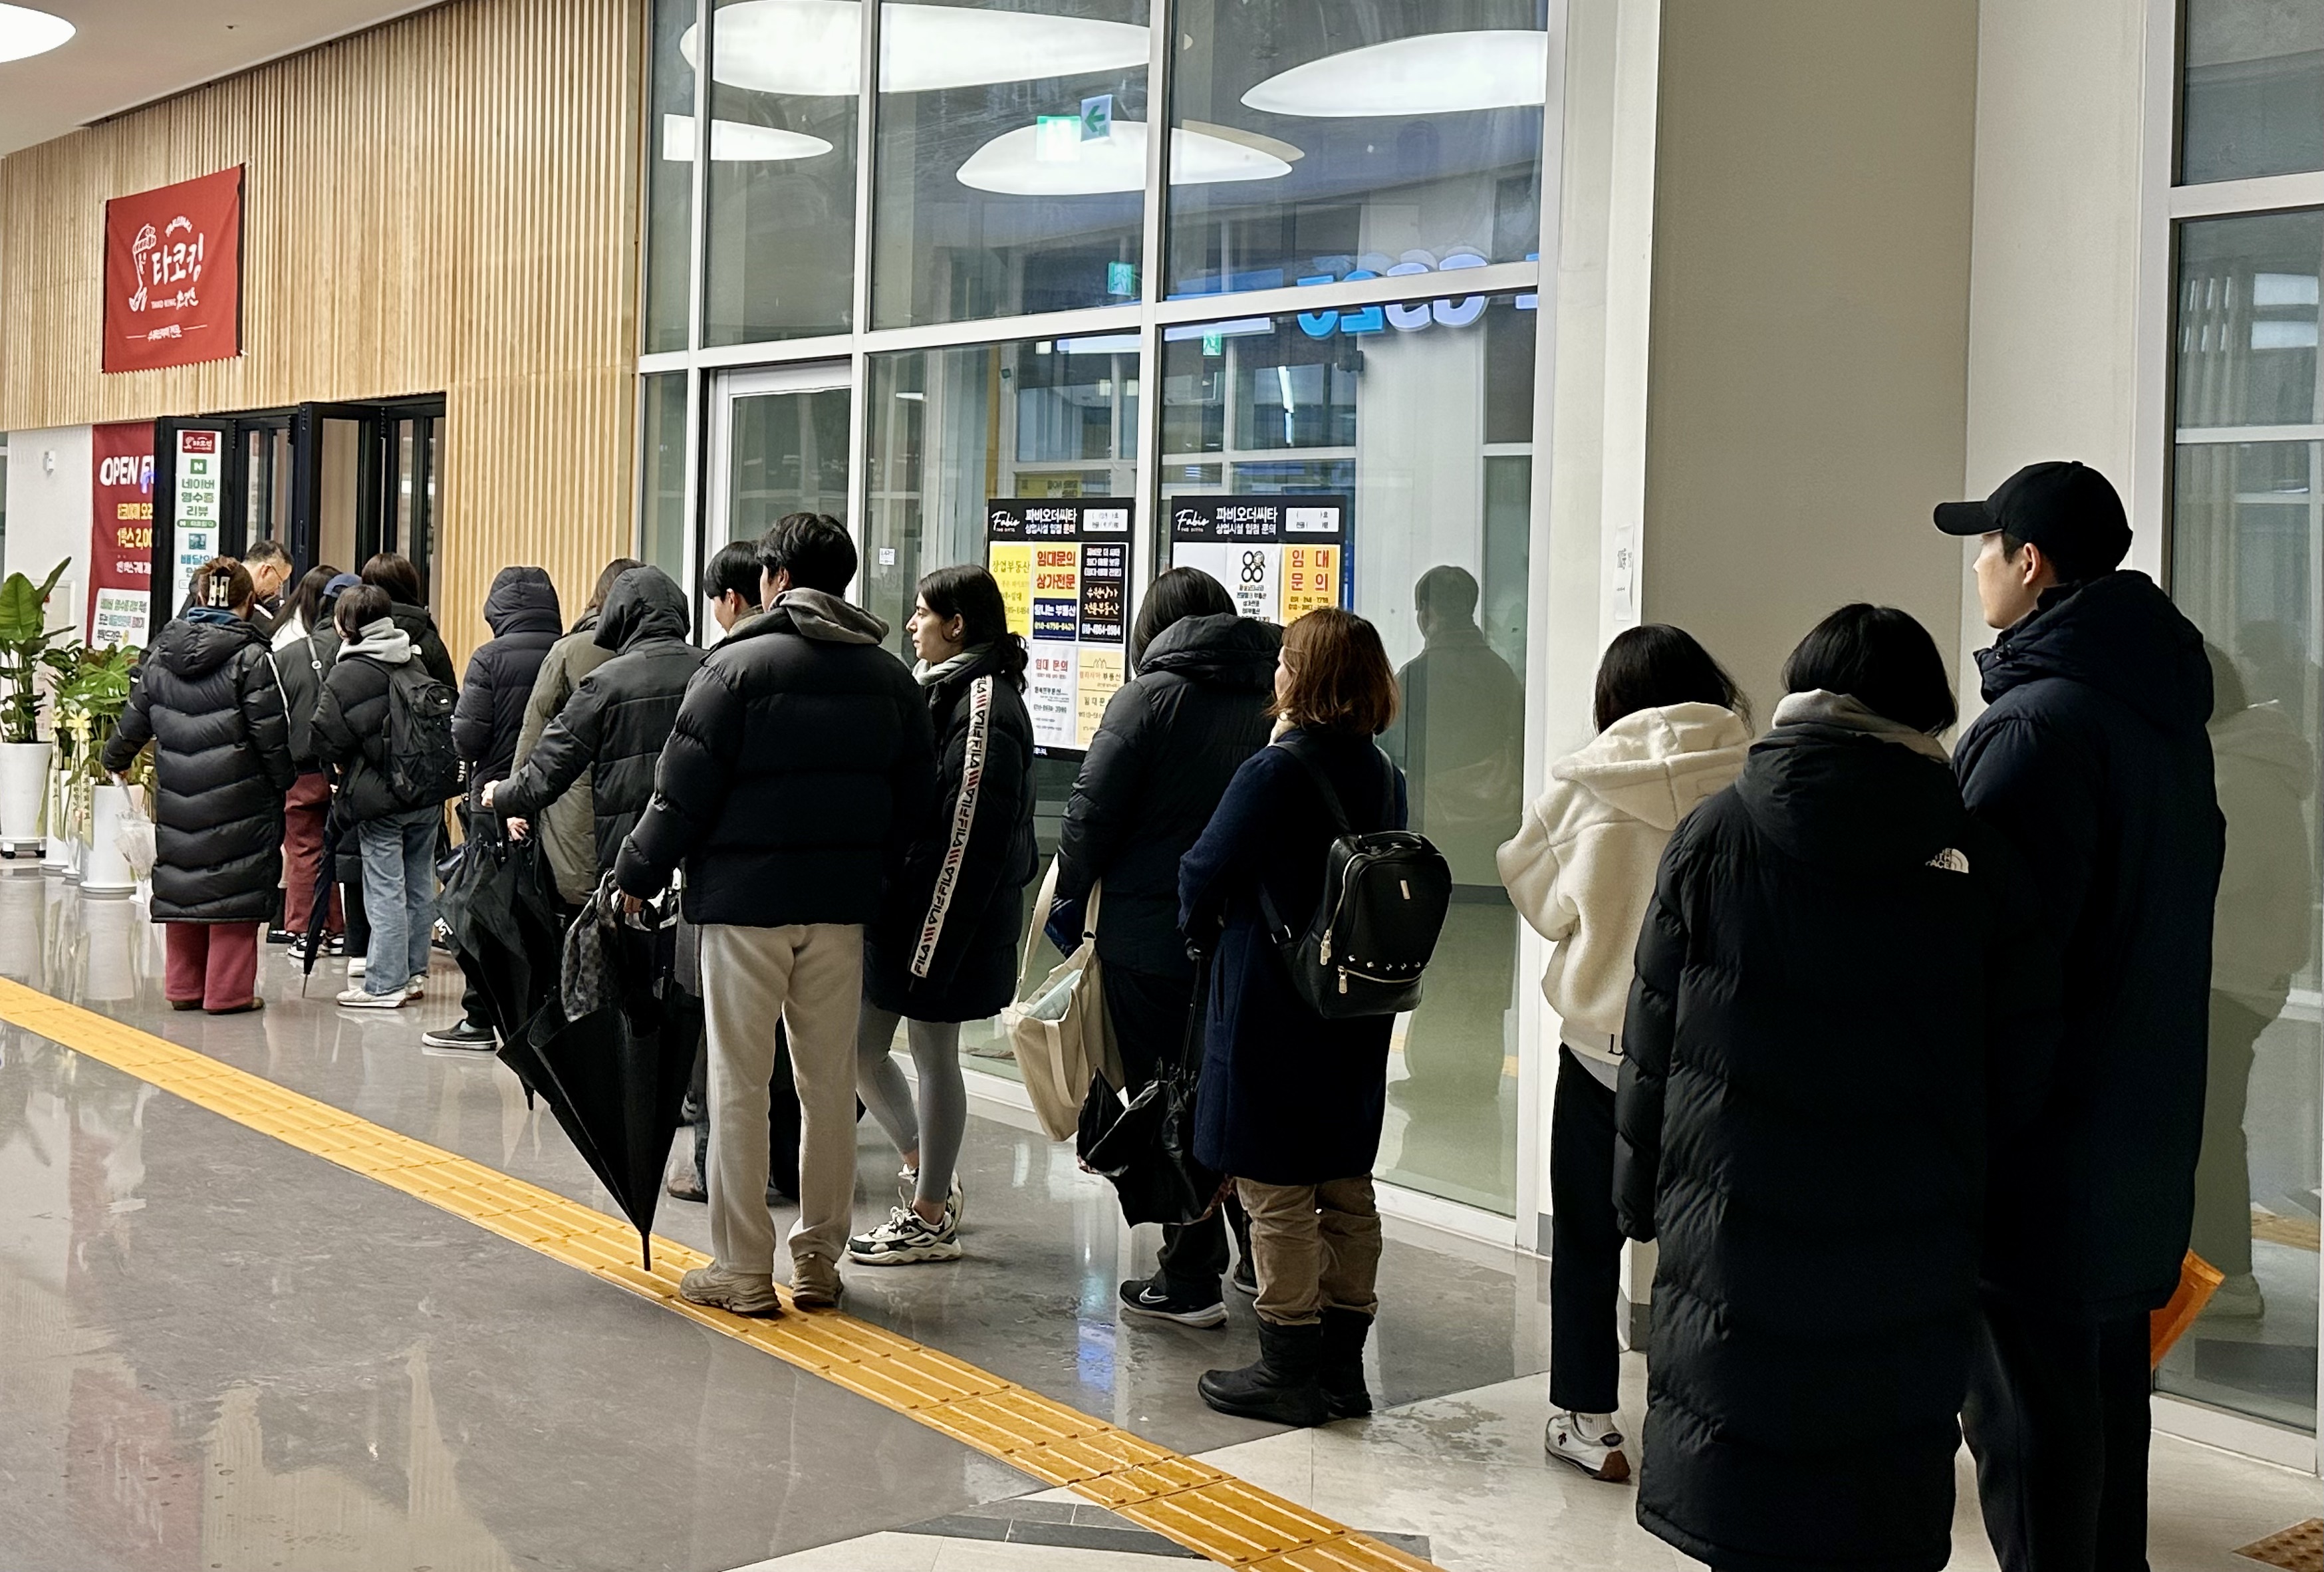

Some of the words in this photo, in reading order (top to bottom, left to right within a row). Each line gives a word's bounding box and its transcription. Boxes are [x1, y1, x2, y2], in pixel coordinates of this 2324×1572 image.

[100, 456, 139, 486] OPEN
[182, 478, 215, 490] 네이버
[186, 506, 209, 517] 리뷰
[991, 511, 1021, 531] Fabio
[1025, 507, 1078, 523] 파비오더씨타
[1175, 509, 1210, 531] Fabio
[1216, 506, 1278, 523] 파비오더씨타
[1037, 551, 1076, 567] 임대문의
[1037, 573, 1075, 590] 상가전문
[973, 710, 986, 739] FILA
[969, 740, 983, 769] FILA
[959, 787, 975, 818] FILA
[952, 817, 968, 848] FILA
[938, 866, 955, 896] FILA
[928, 895, 945, 925] FILA
[914, 944, 931, 975] FILA
